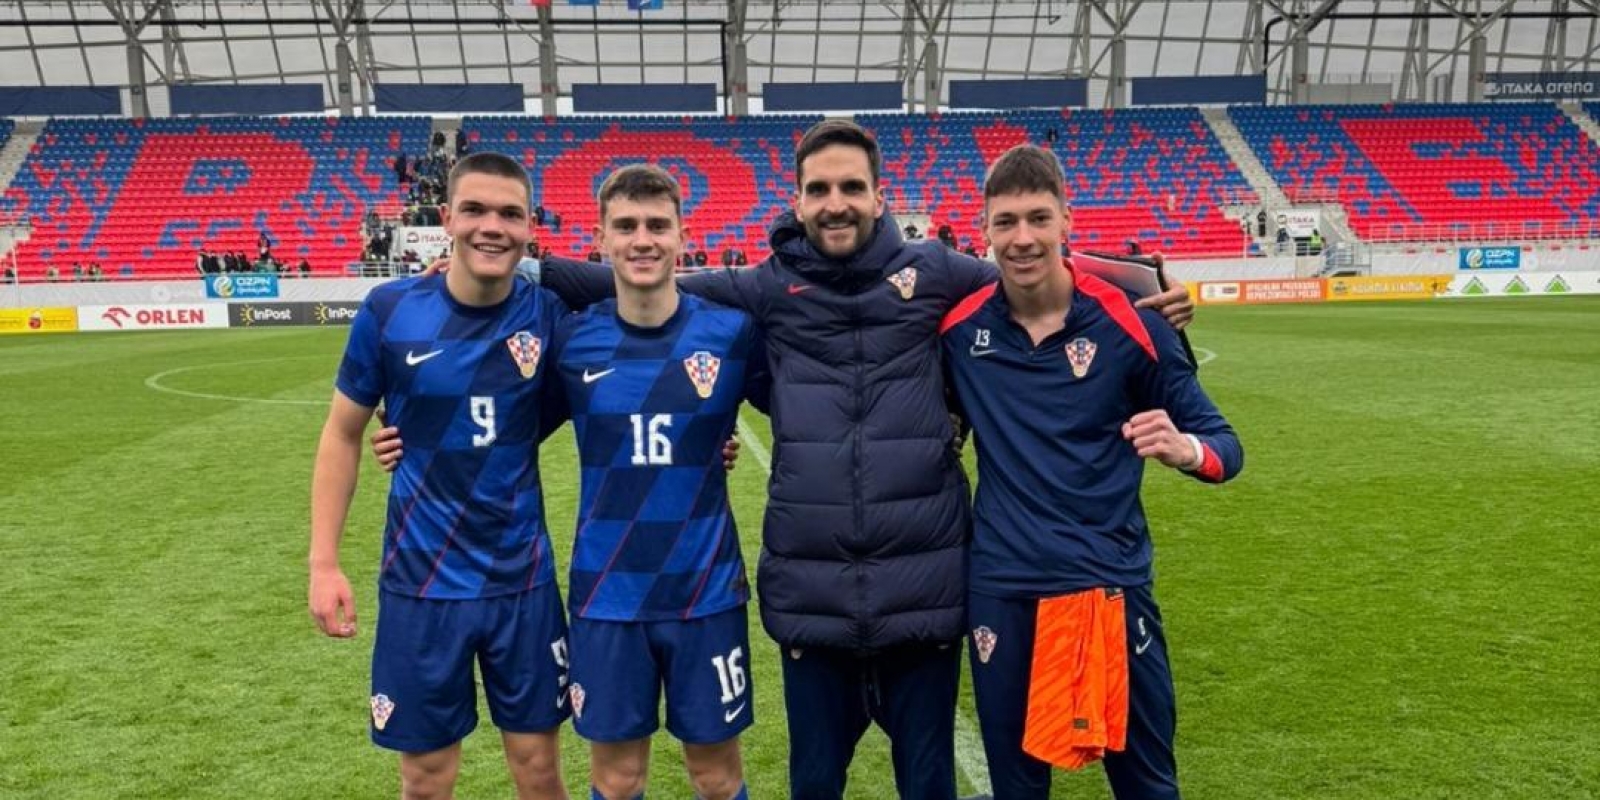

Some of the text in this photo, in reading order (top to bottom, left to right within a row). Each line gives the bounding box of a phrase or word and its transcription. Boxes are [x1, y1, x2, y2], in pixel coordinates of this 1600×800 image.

[1502, 82, 1594, 93] ITAKA arena
[1288, 215, 1315, 223] ITAKA
[136, 309, 204, 325] ORLEN
[255, 308, 291, 320] InPost
[975, 329, 990, 346] 13
[470, 396, 496, 447] 9
[630, 413, 673, 465] 16
[711, 646, 746, 703] 16
